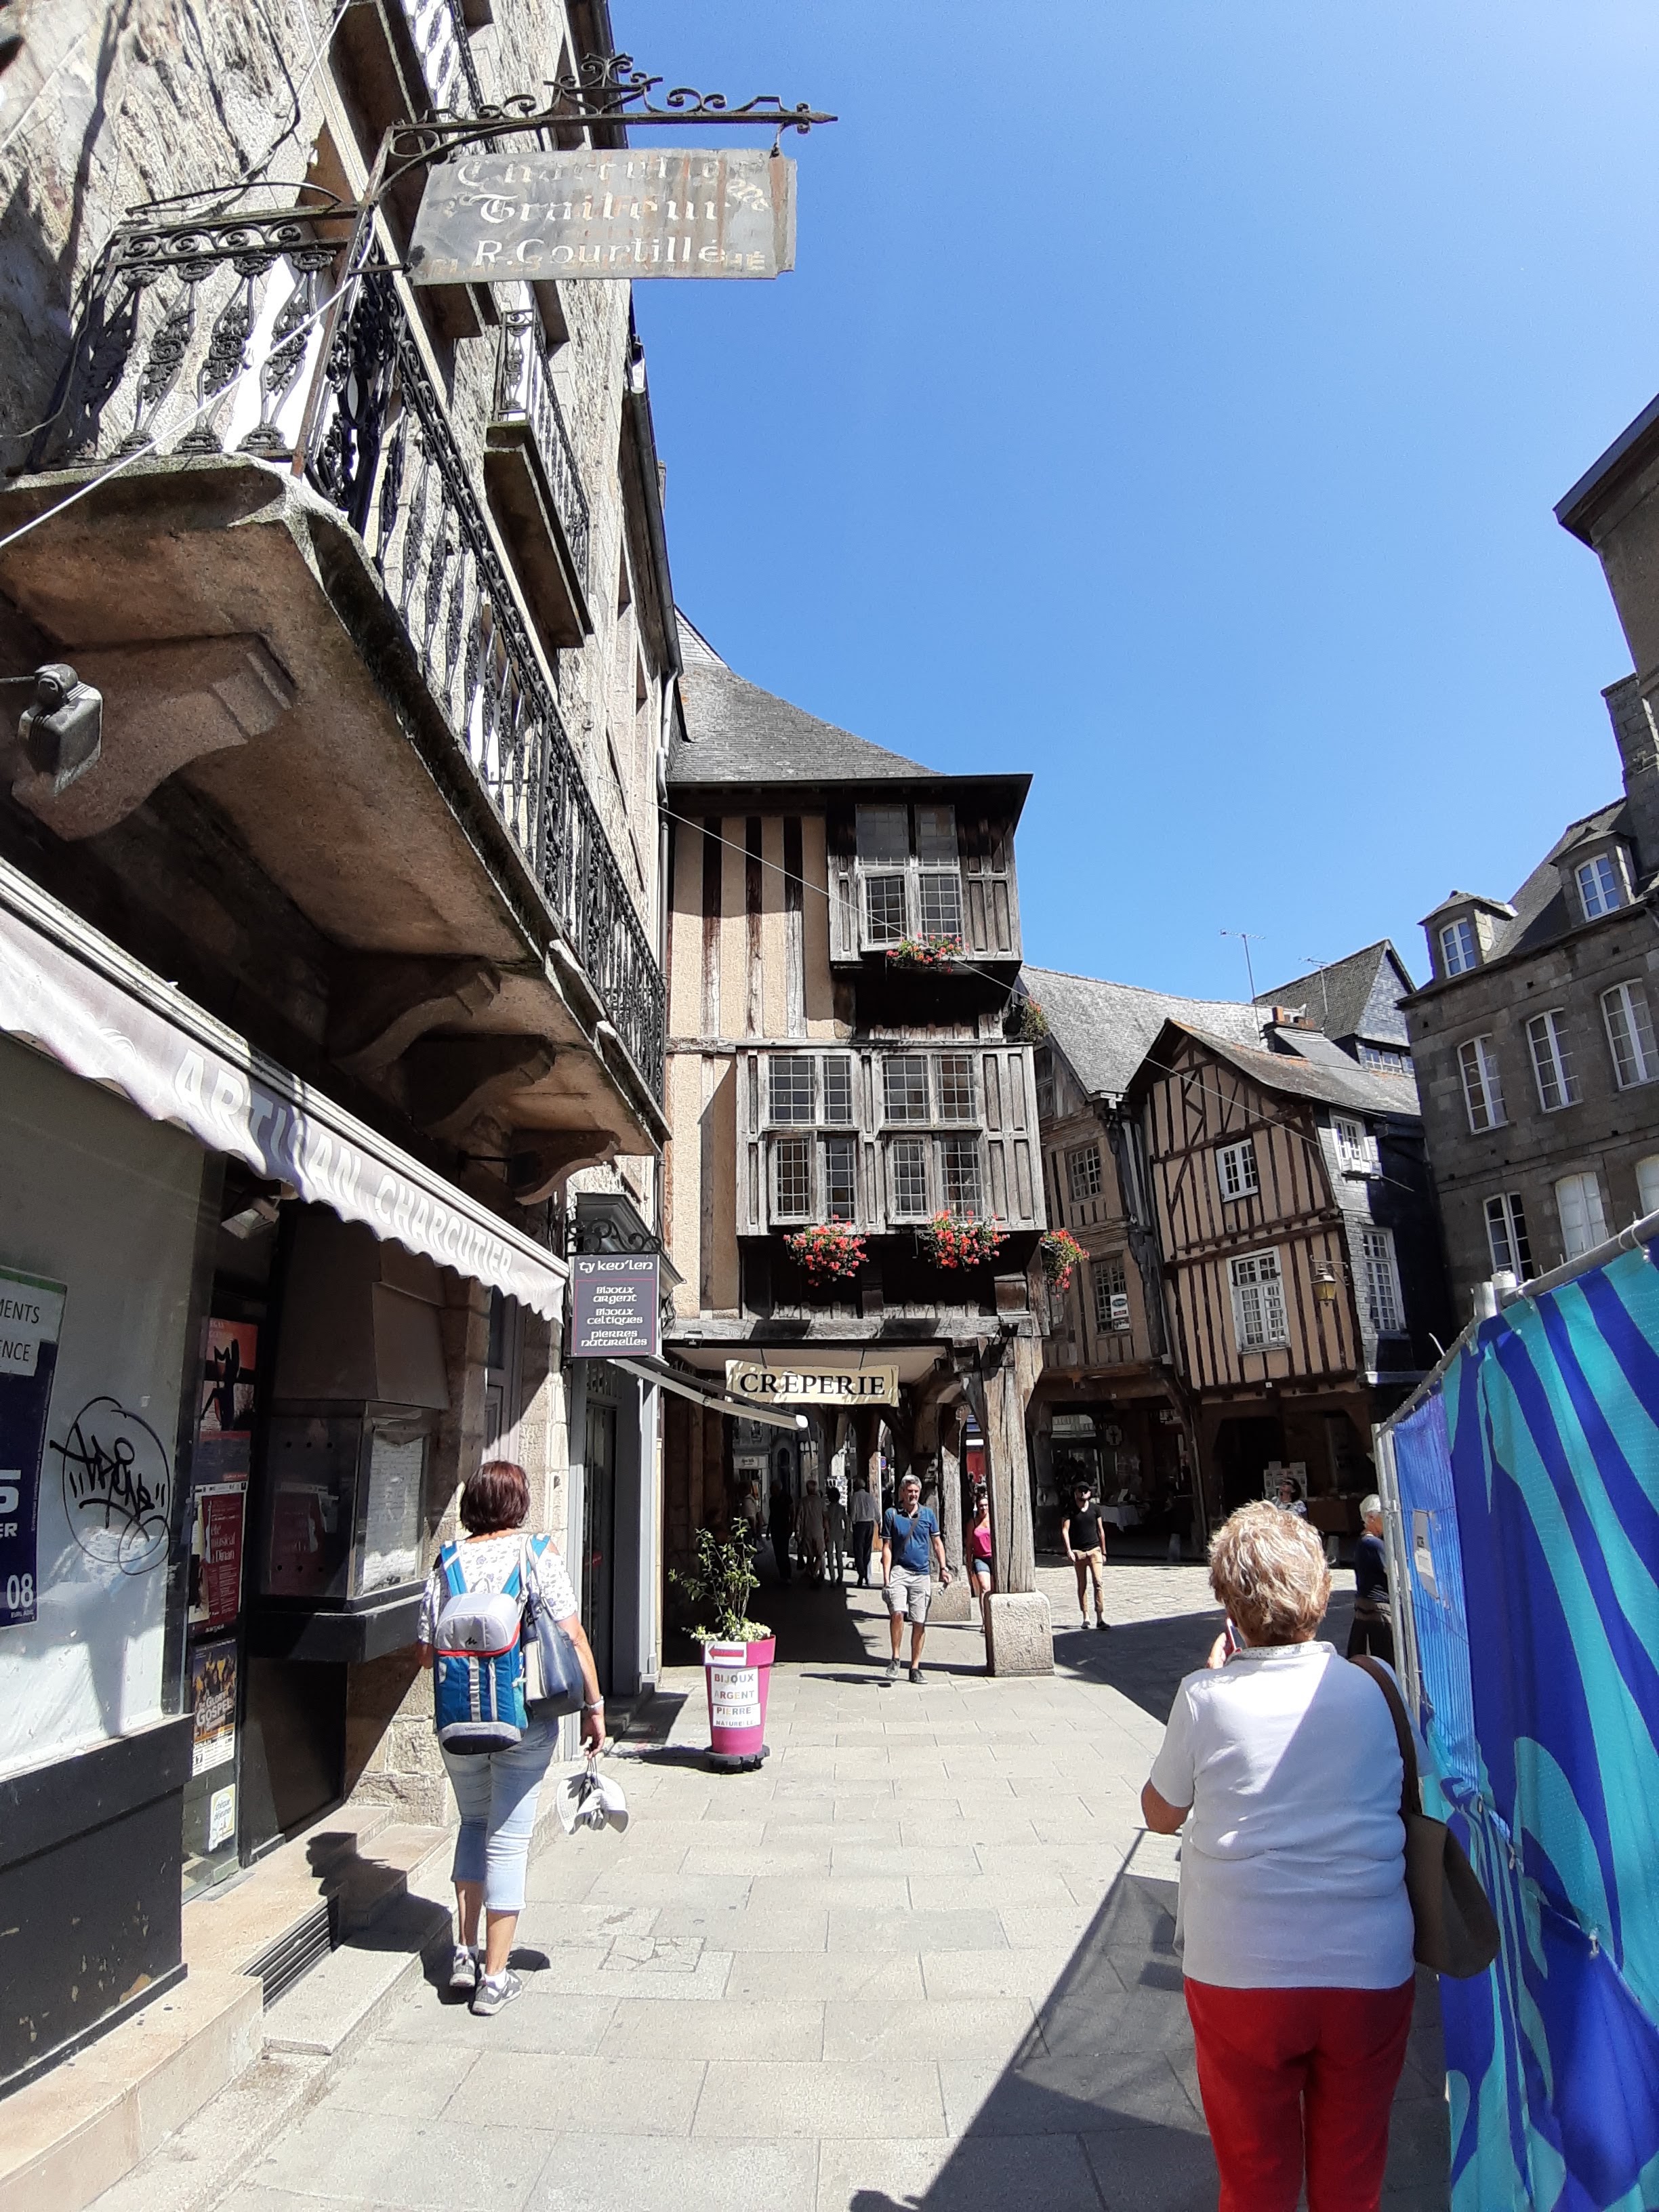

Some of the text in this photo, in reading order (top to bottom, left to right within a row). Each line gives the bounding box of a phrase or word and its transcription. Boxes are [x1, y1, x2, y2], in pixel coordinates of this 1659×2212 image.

[174, 1048, 361, 1207] ARTISAN
[375, 1174, 517, 1287] CHARCUTIER
[0, 1340, 31, 1362] NCE
[215, 1549, 235, 1563] Dinan
[7, 1573, 34, 1610] 08
[714, 1673, 754, 1683] BIJOUX
[714, 1689, 755, 1700] ARGENT
